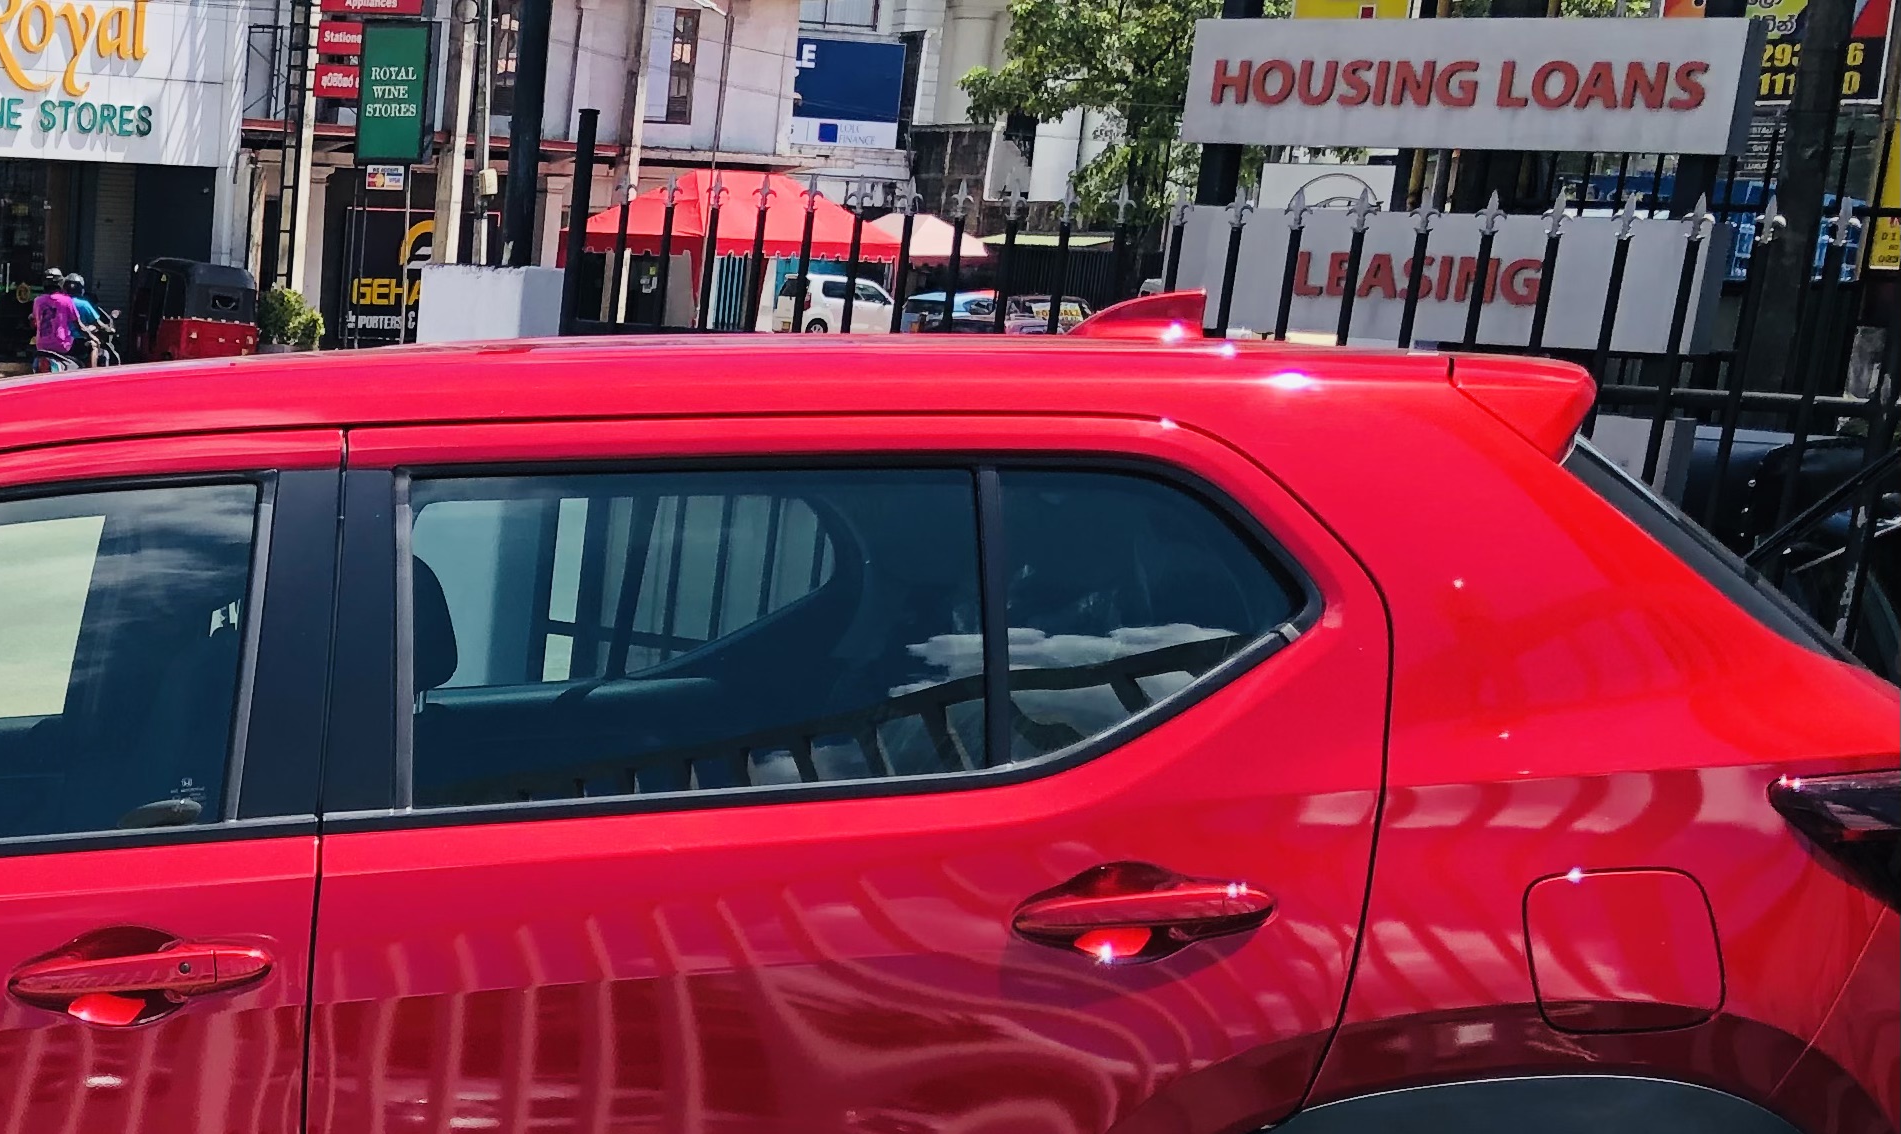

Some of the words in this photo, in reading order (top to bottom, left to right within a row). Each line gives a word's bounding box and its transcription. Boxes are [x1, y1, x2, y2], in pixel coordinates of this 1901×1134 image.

[371, 67, 417, 80] ROYAL
[1210, 58, 1480, 109] HOUSING
[1496, 60, 1711, 110] LOANS
[372, 86, 408, 99] WINE
[37, 100, 153, 137] STORES
[365, 104, 417, 117] STORES
[1294, 250, 1543, 306] LEASING
